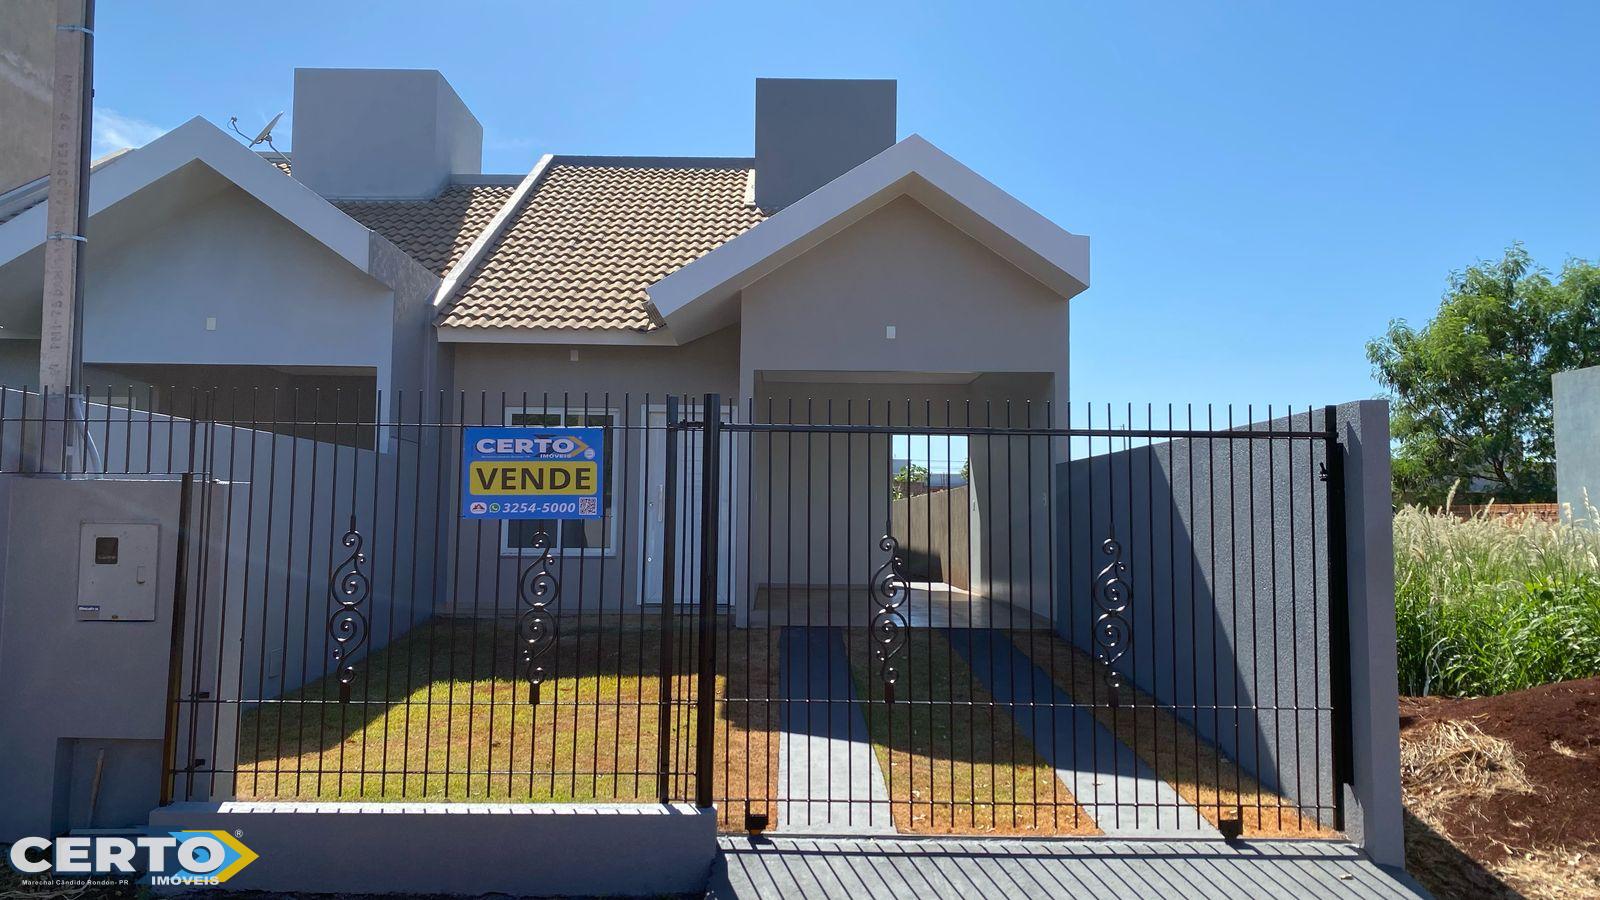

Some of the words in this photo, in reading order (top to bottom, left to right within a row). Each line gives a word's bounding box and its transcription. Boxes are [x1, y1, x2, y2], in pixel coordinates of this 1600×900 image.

[476, 438, 574, 454] CERTO
[476, 467, 591, 490] VENDE
[502, 502, 576, 513] 3254-5000
